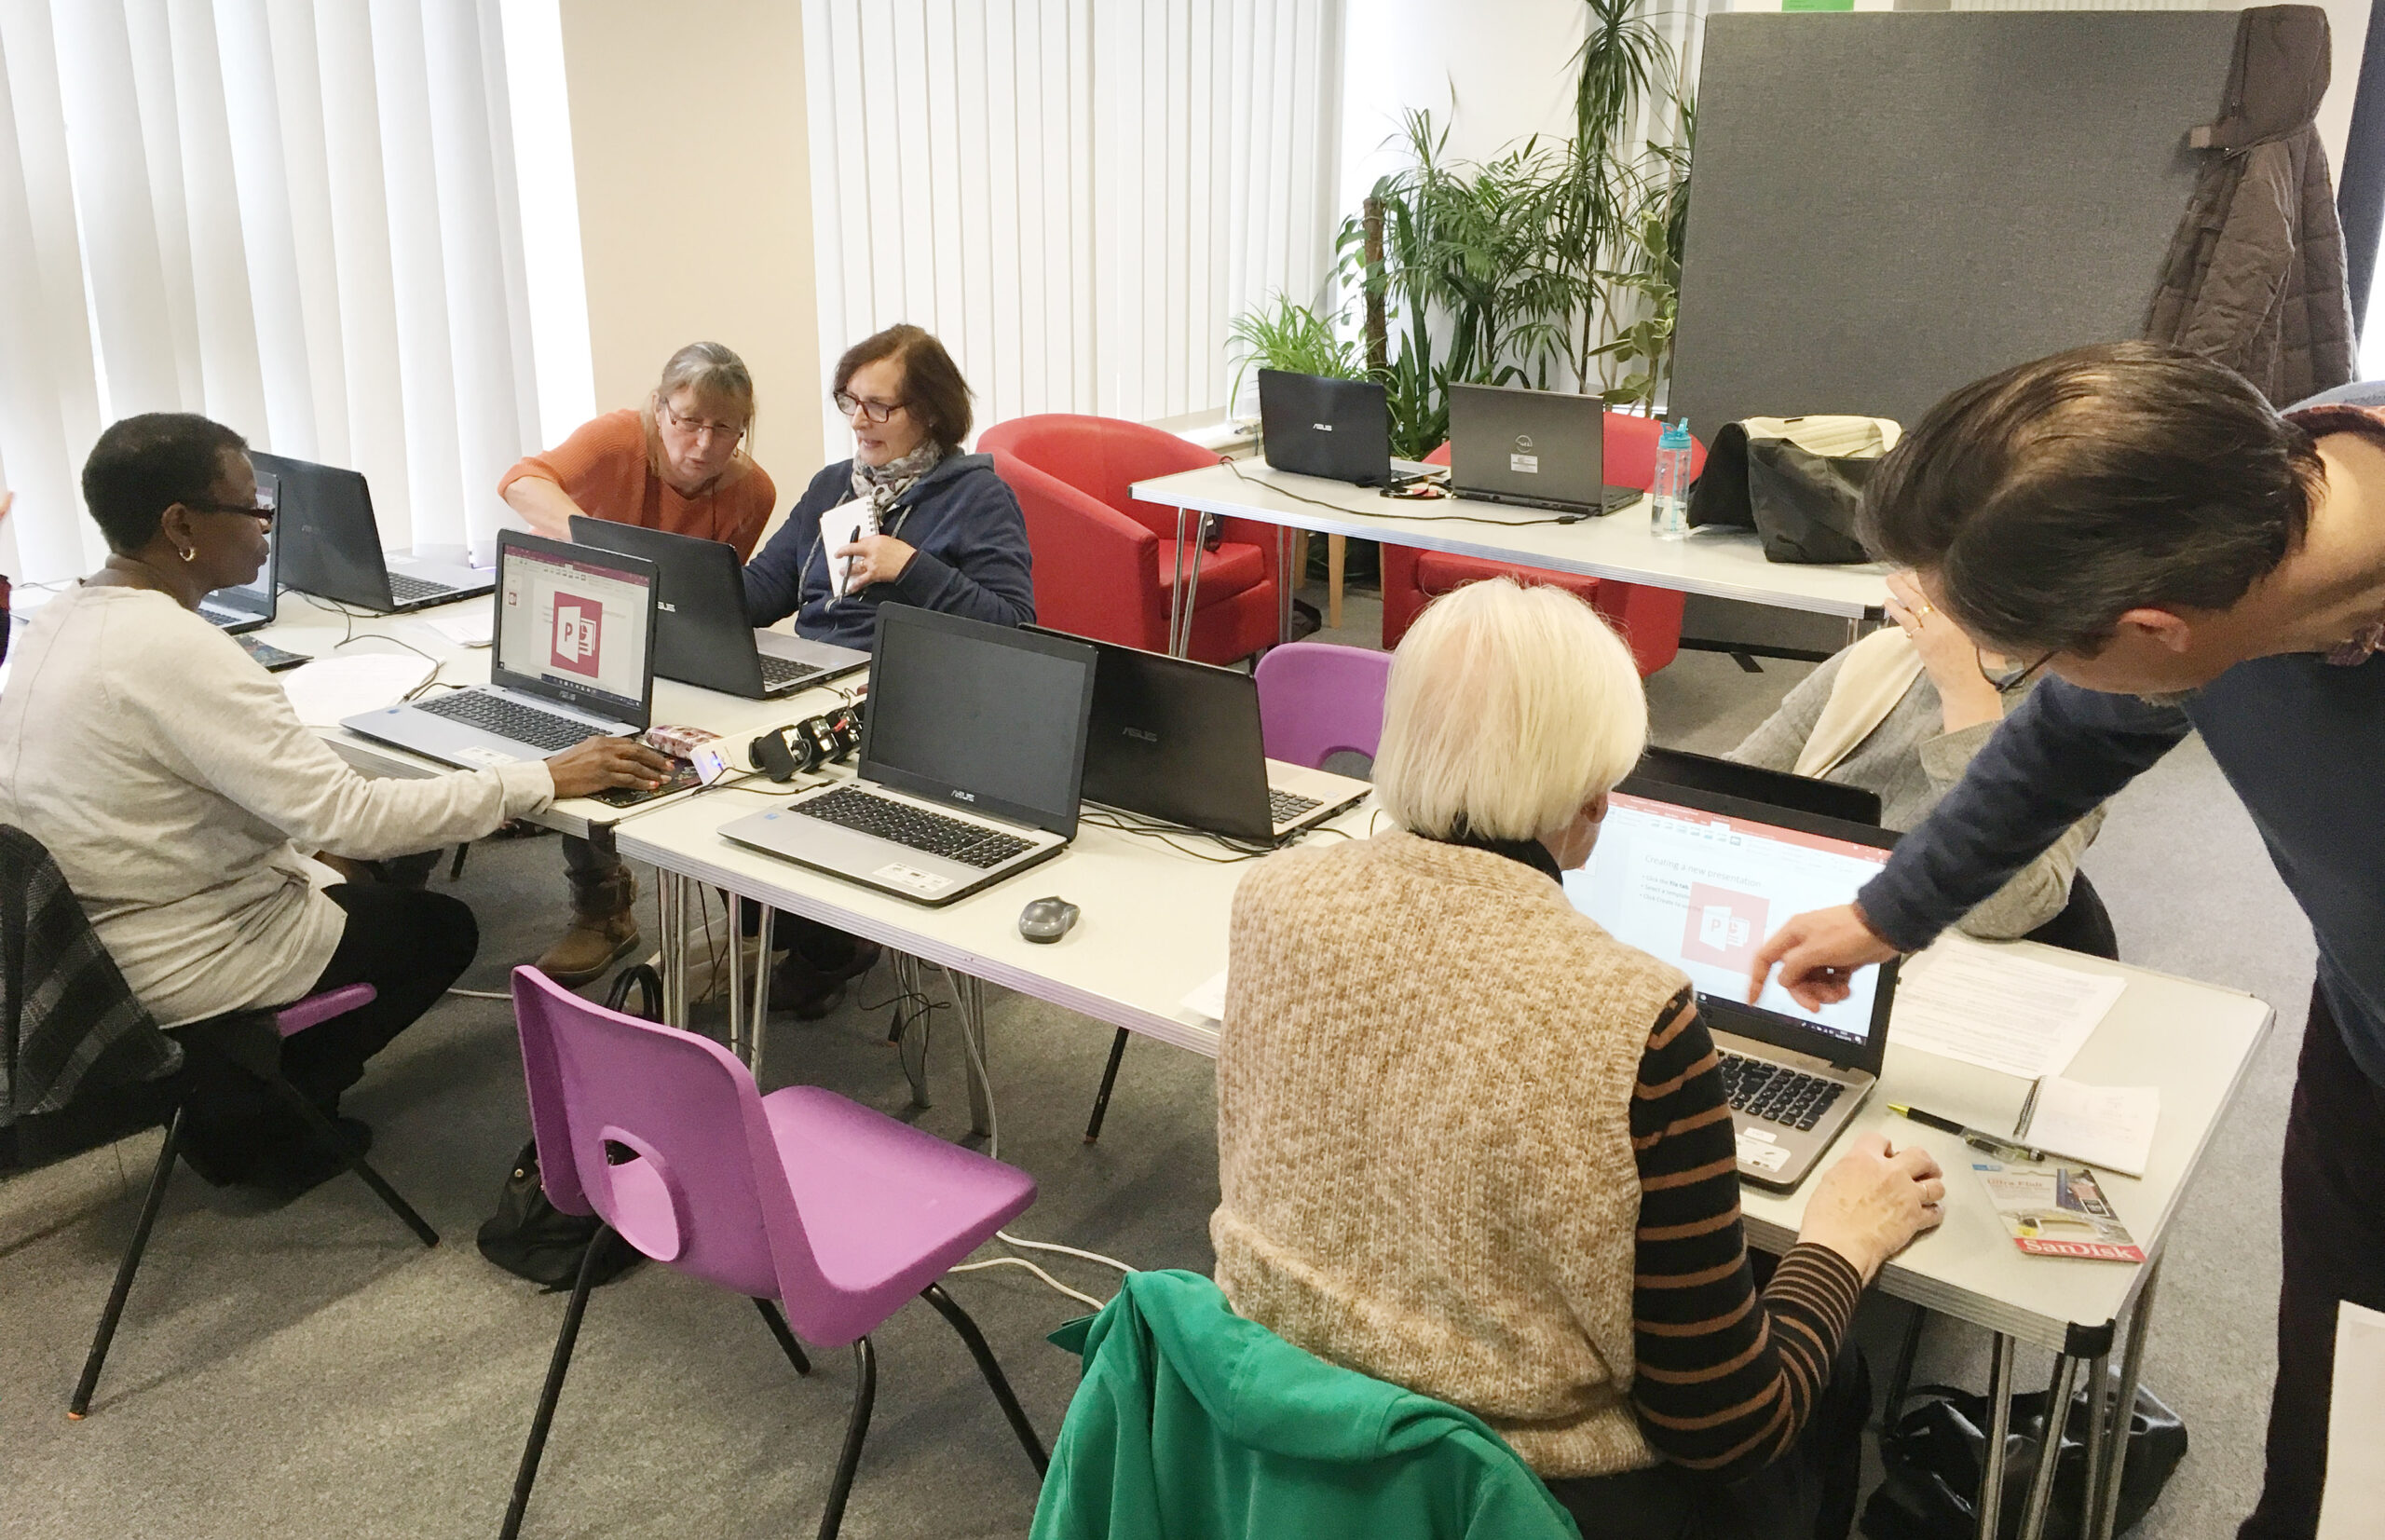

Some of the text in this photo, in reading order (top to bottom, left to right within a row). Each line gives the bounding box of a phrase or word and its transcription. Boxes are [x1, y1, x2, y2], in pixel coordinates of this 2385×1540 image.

[1313, 423, 1332, 431] ASUS
[657, 601, 676, 613] SUS
[564, 621, 573, 642] P
[1122, 726, 1157, 743] ASUS
[950, 789, 974, 802] ASUS
[1644, 854, 1680, 871] Creating
[1688, 865, 1707, 876] new
[1708, 870, 1762, 888] presentation
[2024, 1239, 2135, 1259] SanDisk
